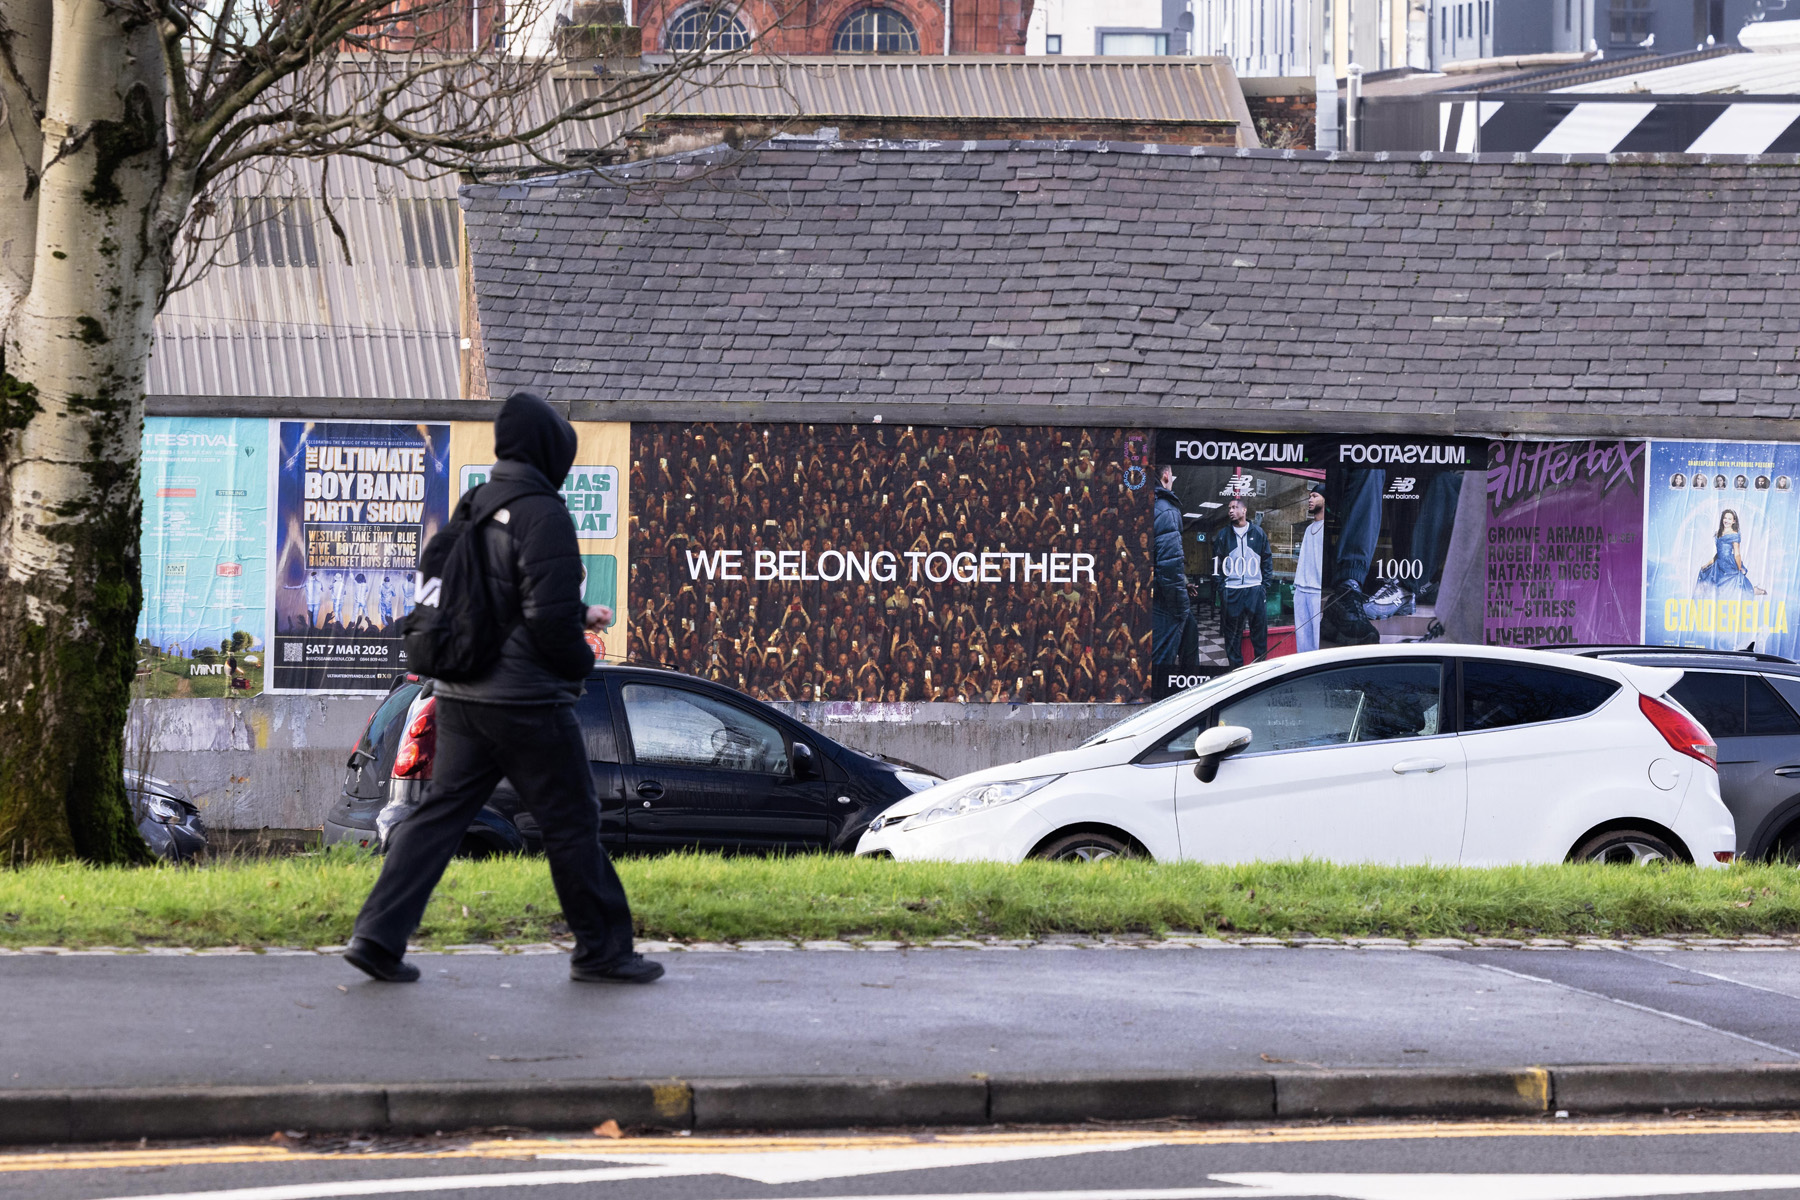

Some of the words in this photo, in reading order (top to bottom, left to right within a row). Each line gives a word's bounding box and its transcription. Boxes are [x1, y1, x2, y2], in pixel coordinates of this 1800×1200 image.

[154, 433, 238, 447] FESTIVAL
[305, 446, 318, 470] THE
[319, 446, 426, 472] ULTIMATE
[1487, 441, 1646, 508] Glitterbox
[304, 471, 356, 500] BOY
[356, 472, 425, 501] BAND
[304, 500, 364, 522] PARTY
[366, 501, 424, 523] SHOW
[308, 530, 347, 542] WESTLIFE
[351, 531, 371, 542] TAKE
[372, 531, 393, 543] THAT
[397, 532, 417, 543] BLUE
[1487, 526, 1540, 544] GROOVE
[1546, 526, 1605, 544] ARMADA
[1607, 533, 1617, 544] DJ
[1620, 533, 1636, 543] SET
[308, 542, 330, 555] 5IVE
[335, 542, 378, 556] BOYZONE
[383, 543, 417, 557] NSYNC
[1487, 545, 1535, 562] ROGER
[1538, 544, 1601, 562] SANCHEZ
[308, 556, 360, 567] BACKSTREET
[361, 556, 381, 567] BOYS
[382, 556, 391, 568] &
[392, 556, 416, 568] MORE
[685, 550, 743, 581] WE
[754, 550, 897, 582] BELONG
[904, 551, 1095, 583] TOGETHER
[1211, 556, 1259, 577] 1000
[1376, 558, 1423, 579] 1000
[1487, 563, 1552, 581] NATASHA
[1558, 563, 1600, 580] DIGGS
[1487, 582, 1514, 600] FAT
[1520, 582, 1556, 599] TONY
[1486, 600, 1577, 618] MIX-STRESS
[1663, 597, 1789, 634] CINDERELLA
[1485, 625, 1579, 646] LIVERPOOL
[306, 644, 326, 655] SAT
[327, 645, 335, 655] 7
[335, 645, 361, 655] MAR
[361, 645, 388, 655] 2026
